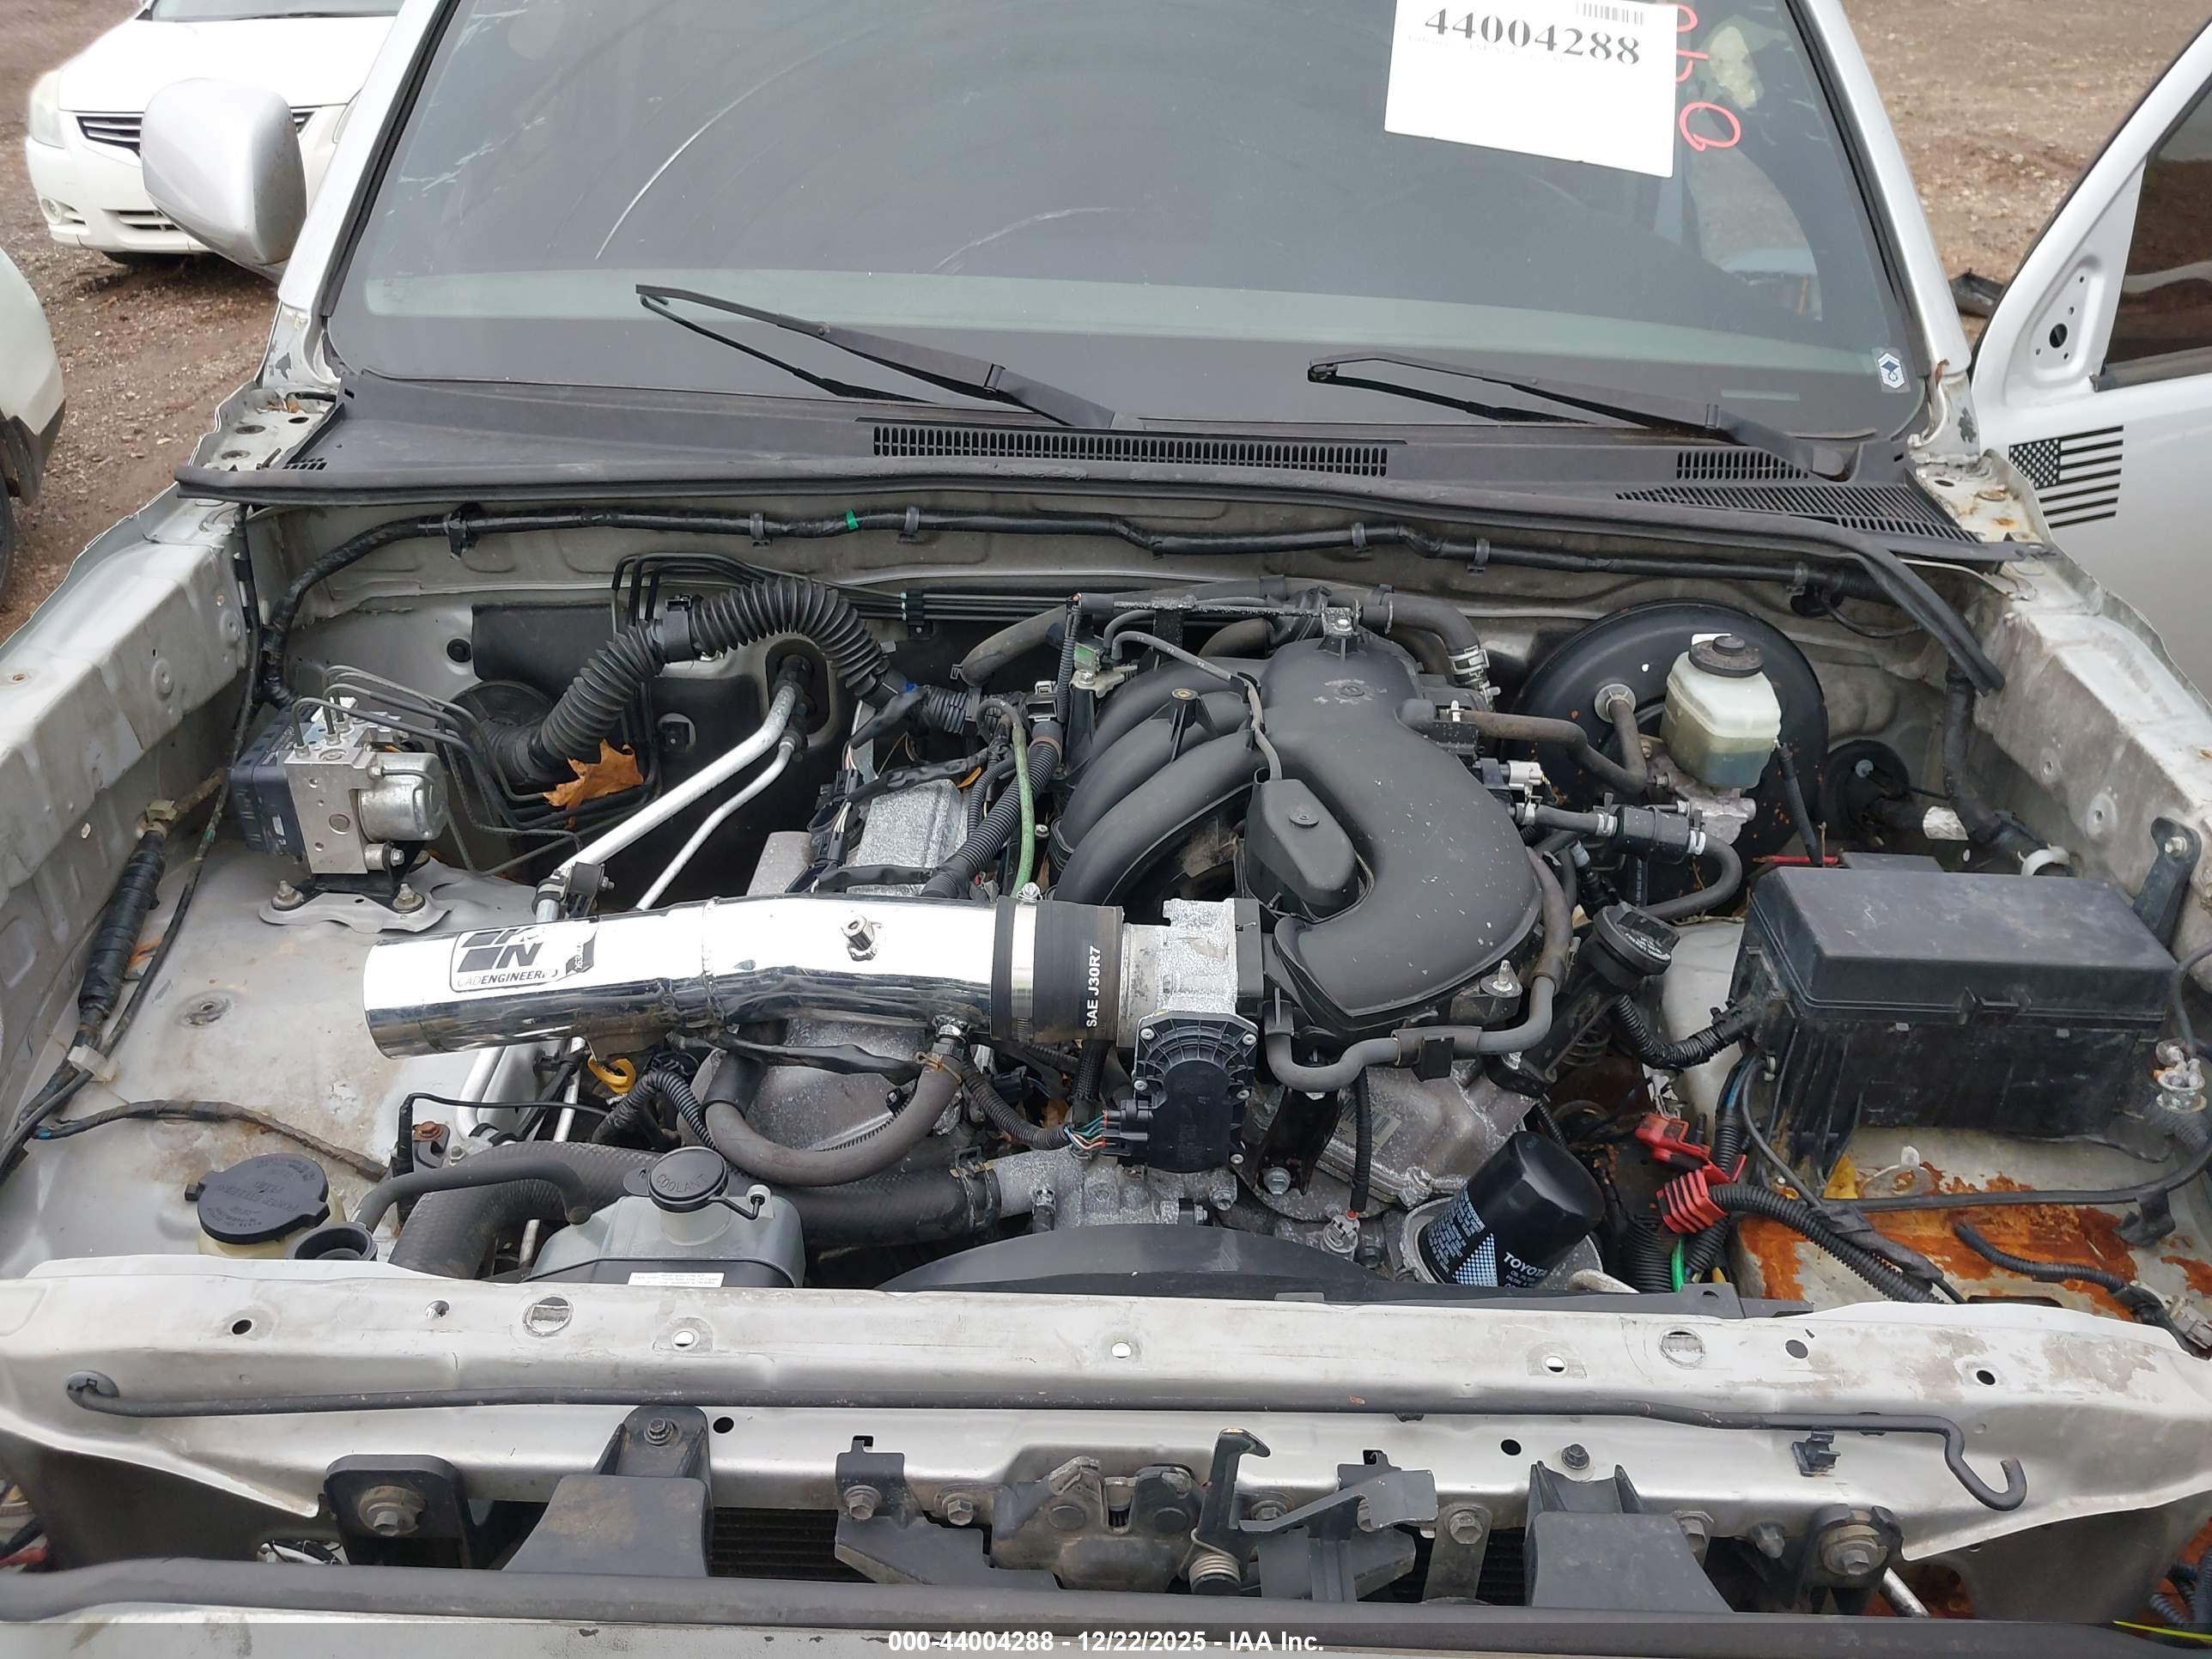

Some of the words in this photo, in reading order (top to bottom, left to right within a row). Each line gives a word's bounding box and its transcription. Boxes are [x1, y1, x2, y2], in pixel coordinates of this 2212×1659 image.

[1425, 8, 1640, 65] 44004288
[1088, 945, 1101, 996] J30R7
[1086, 1000, 1098, 1027] SAE
